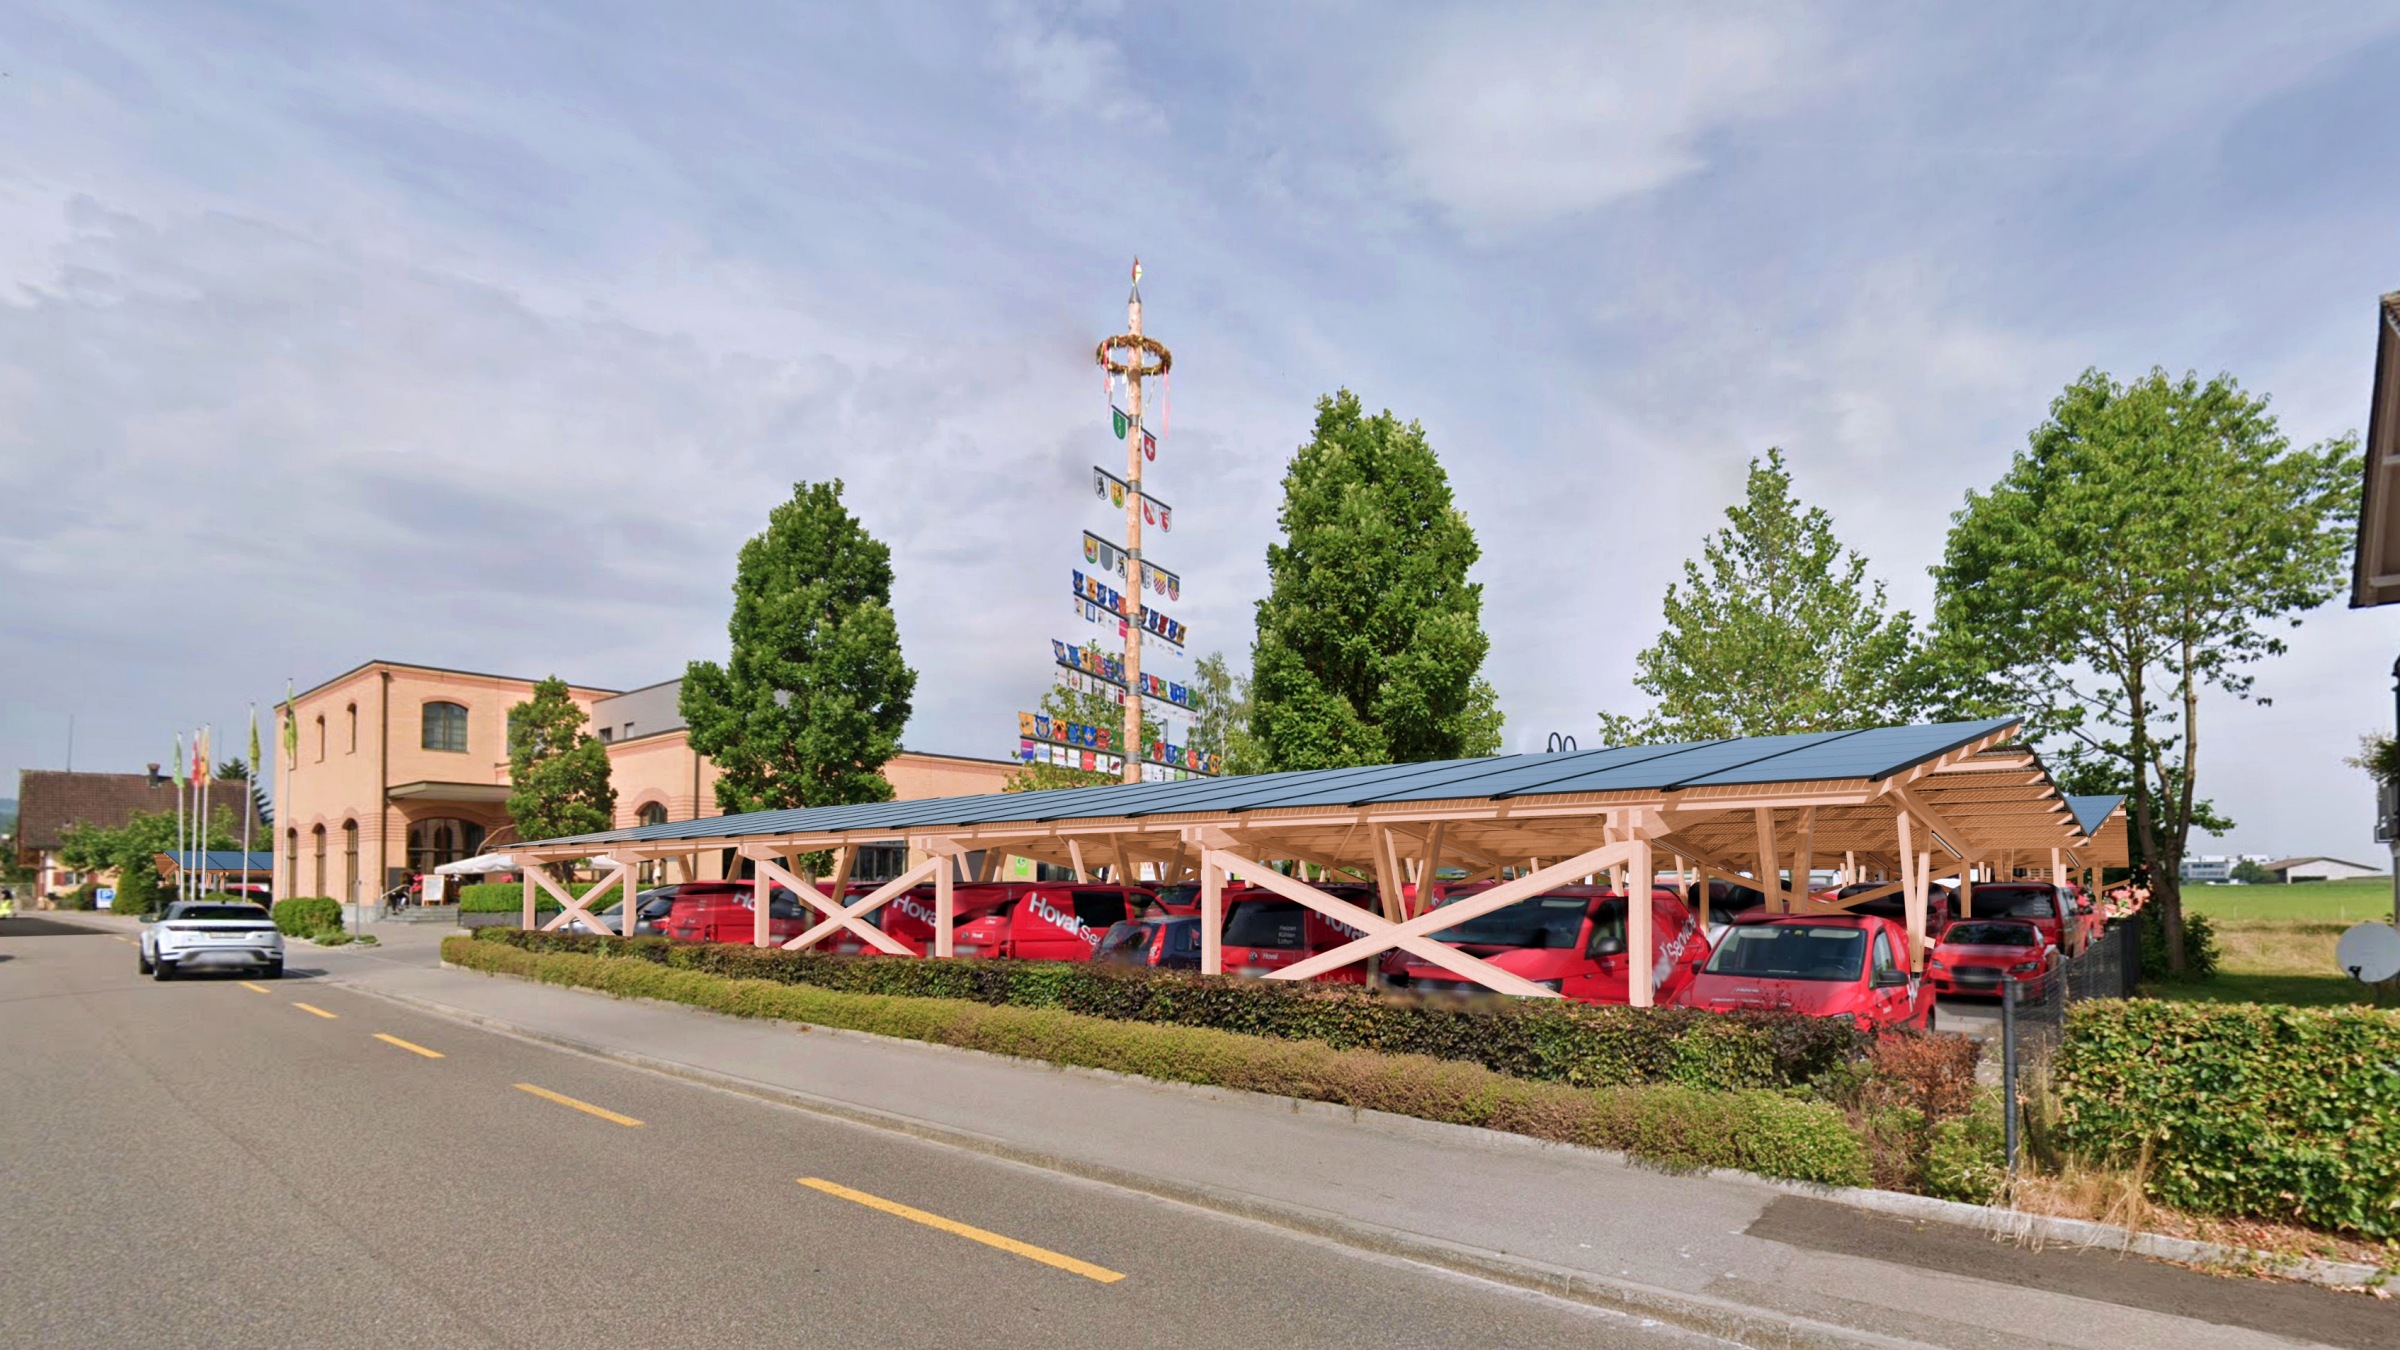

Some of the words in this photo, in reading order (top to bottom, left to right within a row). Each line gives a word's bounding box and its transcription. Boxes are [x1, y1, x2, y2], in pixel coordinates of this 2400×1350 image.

[892, 895, 937, 928] Hova
[1028, 892, 1080, 936] Hoval
[1262, 952, 1279, 960] Hoval
